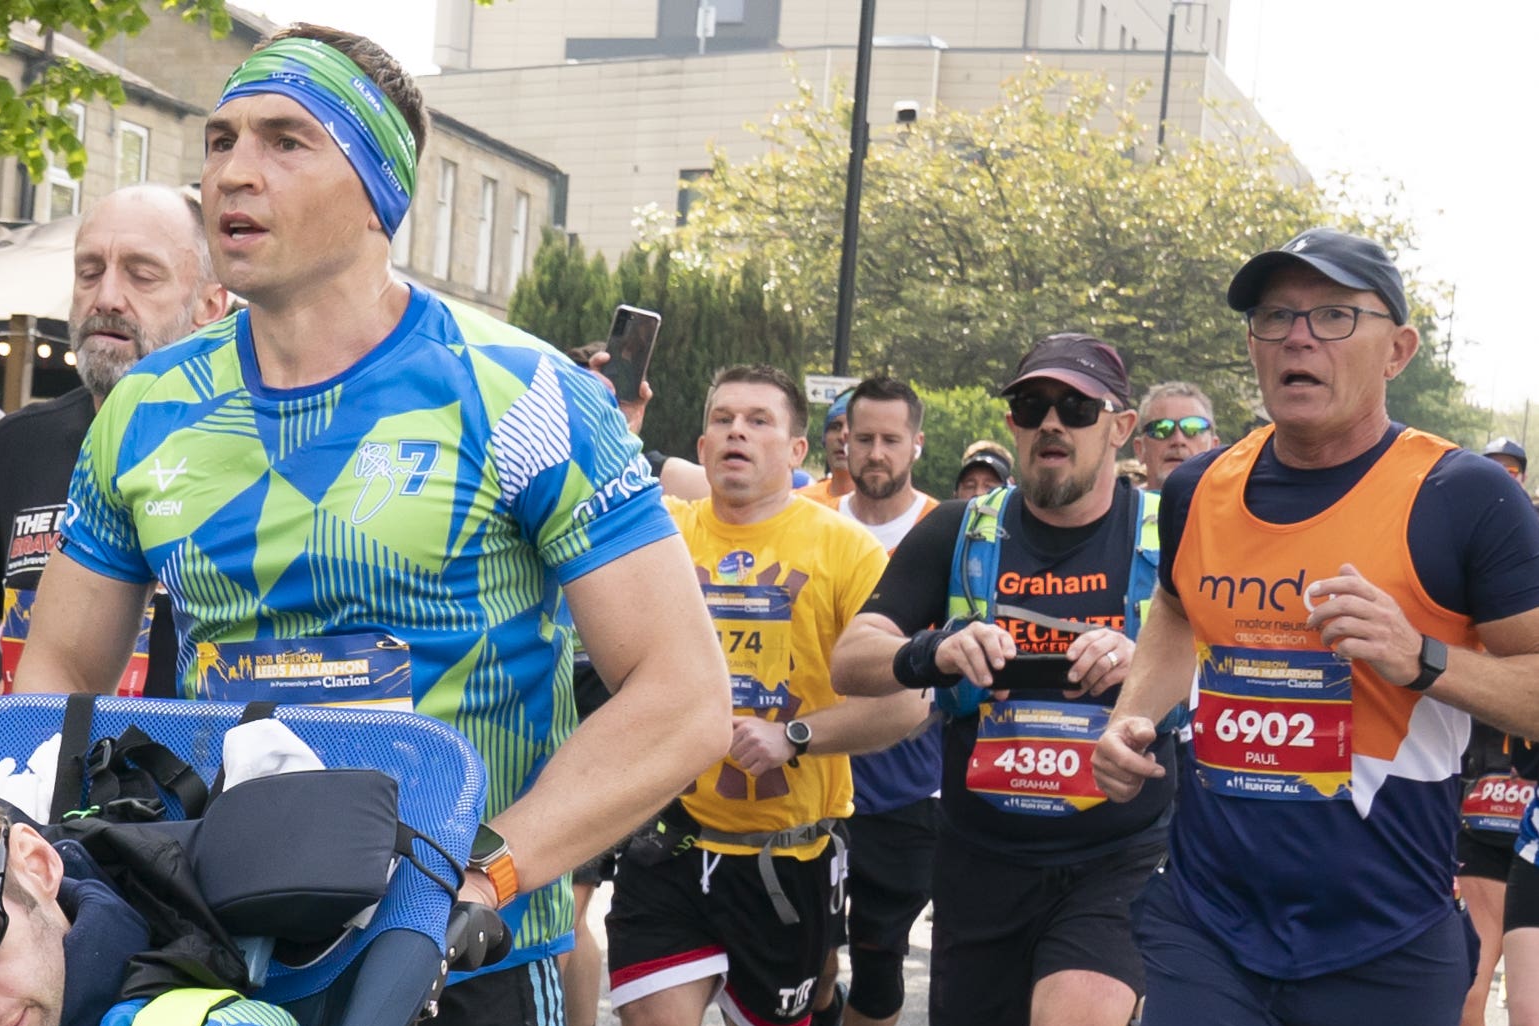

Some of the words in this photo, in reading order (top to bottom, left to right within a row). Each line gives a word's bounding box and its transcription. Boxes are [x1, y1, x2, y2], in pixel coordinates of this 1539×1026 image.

[144, 500, 182, 516] OXEN
[15, 511, 54, 537] THE
[998, 571, 1108, 596] Graham
[1198, 568, 1306, 612] mnd
[322, 674, 370, 688] Clarion
[1215, 708, 1315, 748] 6902
[993, 746, 1081, 778] 4380
[1245, 751, 1280, 766] PAUL
[1009, 778, 1060, 791] GRAHAM
[1480, 782, 1536, 805] 9860
